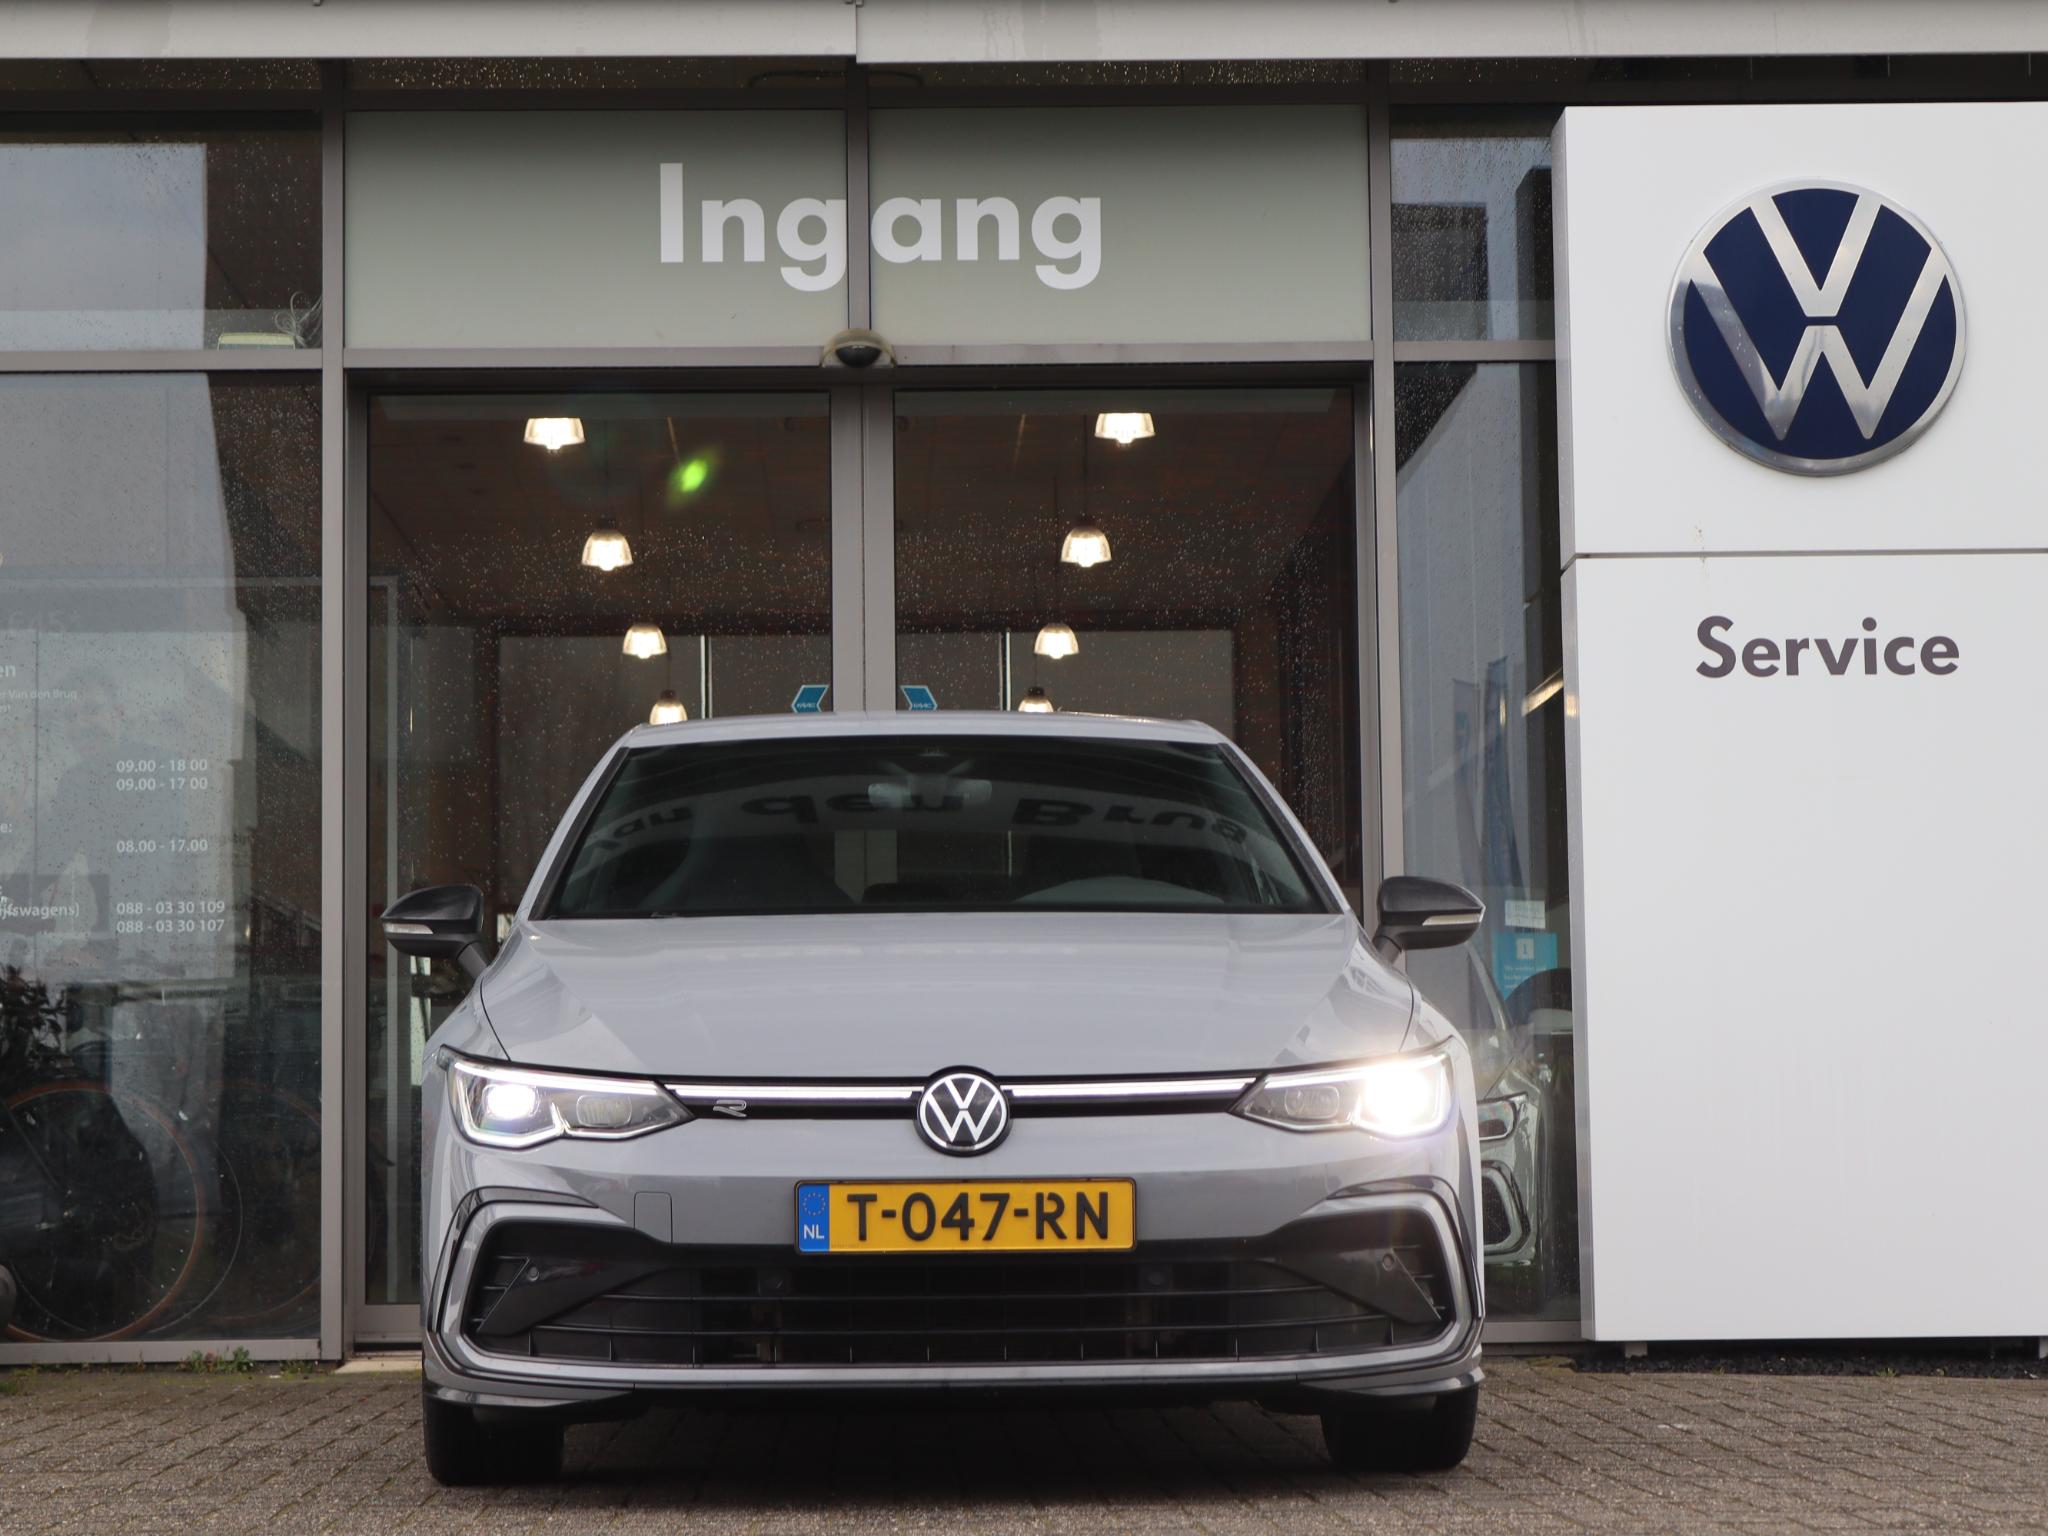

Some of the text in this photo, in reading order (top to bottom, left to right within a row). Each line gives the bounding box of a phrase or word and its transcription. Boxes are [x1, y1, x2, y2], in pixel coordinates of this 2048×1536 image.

[660, 162, 1102, 292] Ingang
[1696, 615, 1960, 679] Service
[30, 687, 50, 699] den
[116, 759, 156, 773] 09.00
[116, 777, 156, 791] 09.00
[116, 840, 156, 853] 08.00
[170, 838, 208, 852] 17.00
[116, 901, 143, 915] 088
[156, 901, 173, 914] 03
[177, 900, 195, 914] 30
[200, 900, 225, 913] 109
[116, 920, 143, 933] 088
[156, 919, 173, 933] 03
[177, 919, 195, 932] 30
[200, 918, 225, 932] 107
[846, 1191, 1109, 1242] T-047-RN
[803, 1224, 825, 1240] NL
